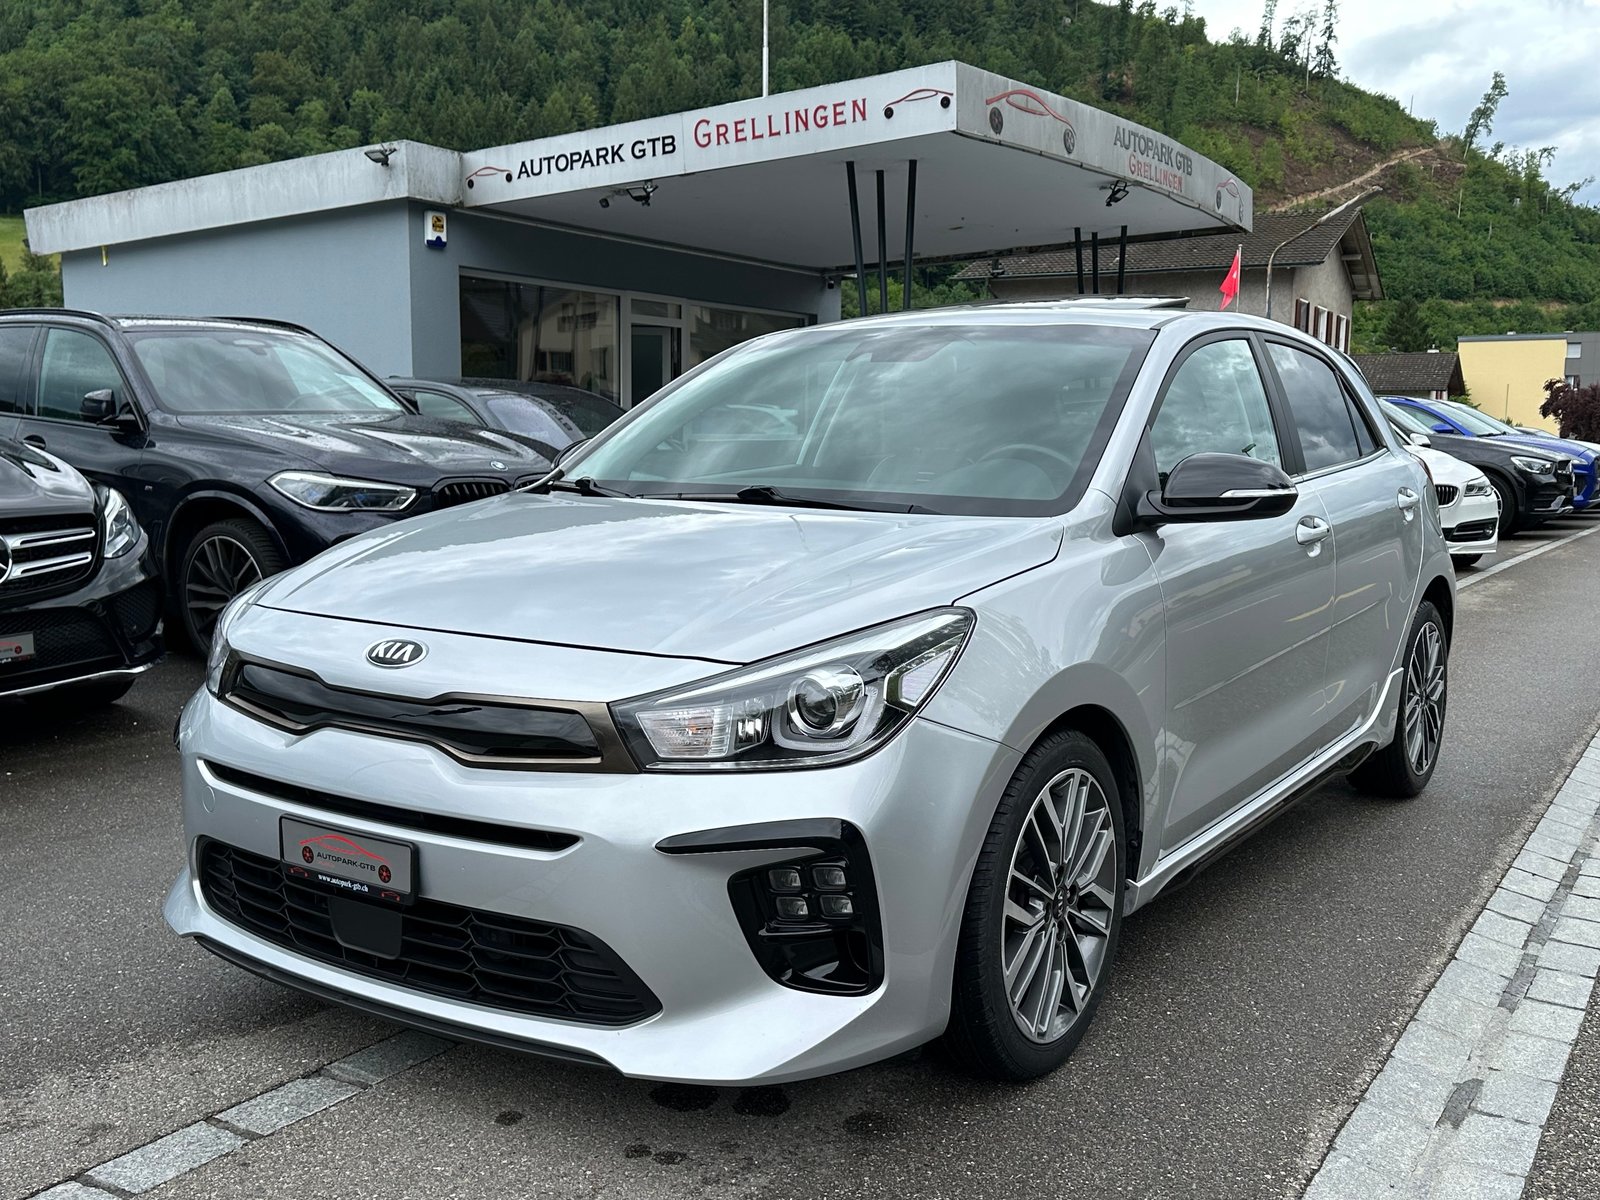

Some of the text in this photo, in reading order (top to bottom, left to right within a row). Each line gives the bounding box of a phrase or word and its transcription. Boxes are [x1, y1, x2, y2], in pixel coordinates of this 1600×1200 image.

[694, 98, 867, 148] GRELLINGEN
[517, 135, 676, 179] AUTOPARK GTB
[1113, 126, 1193, 176] AUTOPARK GTB
[1128, 153, 1183, 193] GRELLINGEN
[371, 641, 415, 662] KIA
[316, 852, 376, 872] AUTOPARK-GTB
[318, 874, 369, 893] www.autopark-gtb.ch
